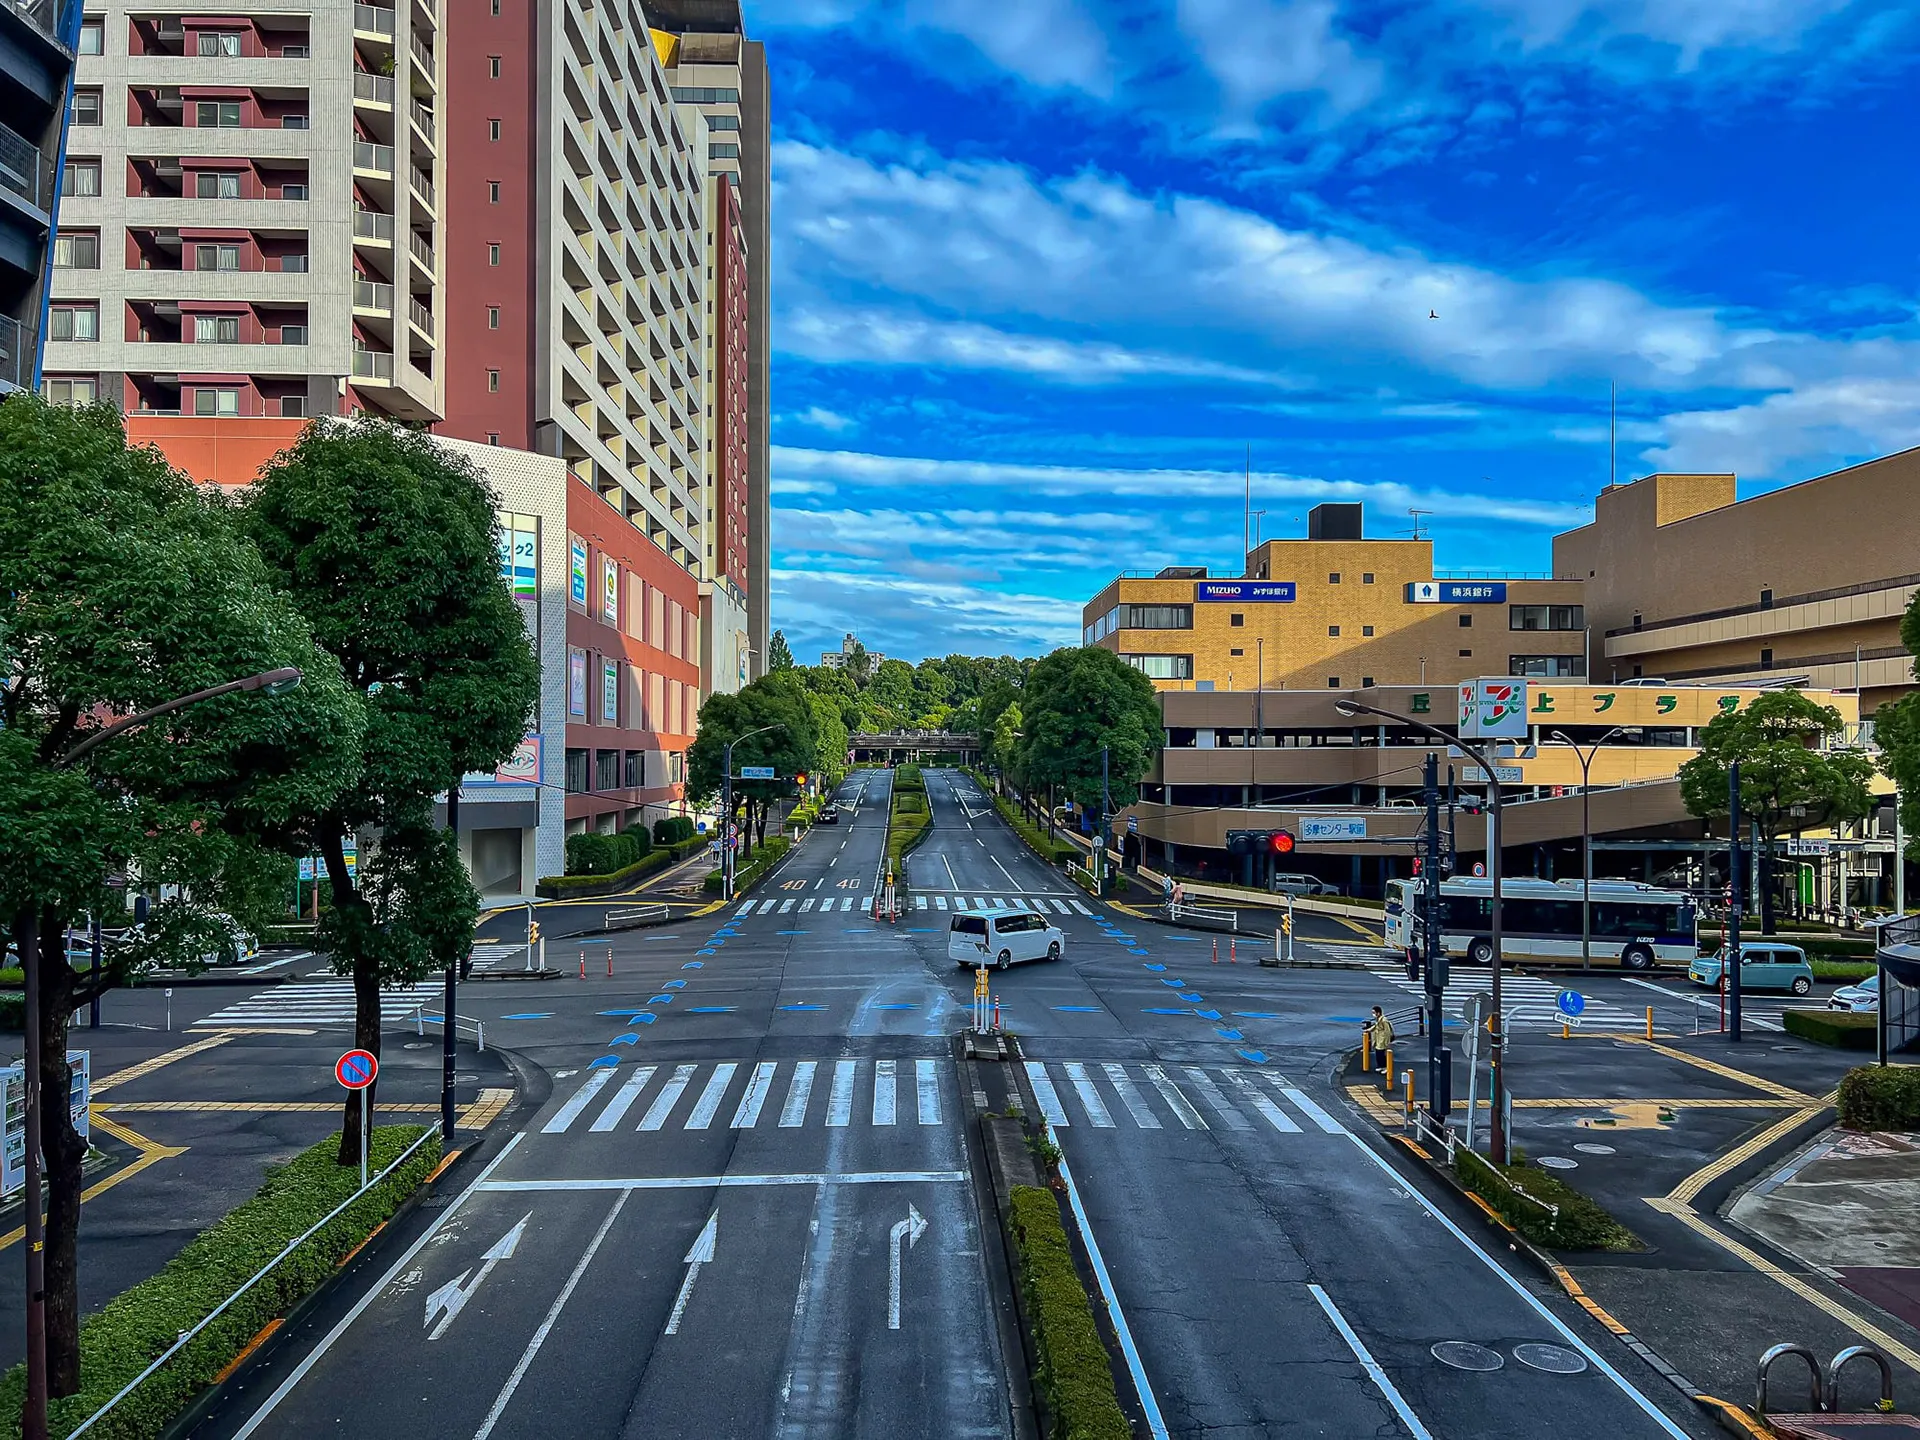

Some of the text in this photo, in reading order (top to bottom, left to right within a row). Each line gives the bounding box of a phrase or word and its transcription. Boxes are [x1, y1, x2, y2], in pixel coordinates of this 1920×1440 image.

[1206, 586, 1241, 594] MIZUHO
[1451, 587, 1493, 597] 横浜銀行
[1305, 823, 1365, 836] 多摩センター駅前
[779, 879, 807, 890] 40
[836, 879, 861, 889] 40
